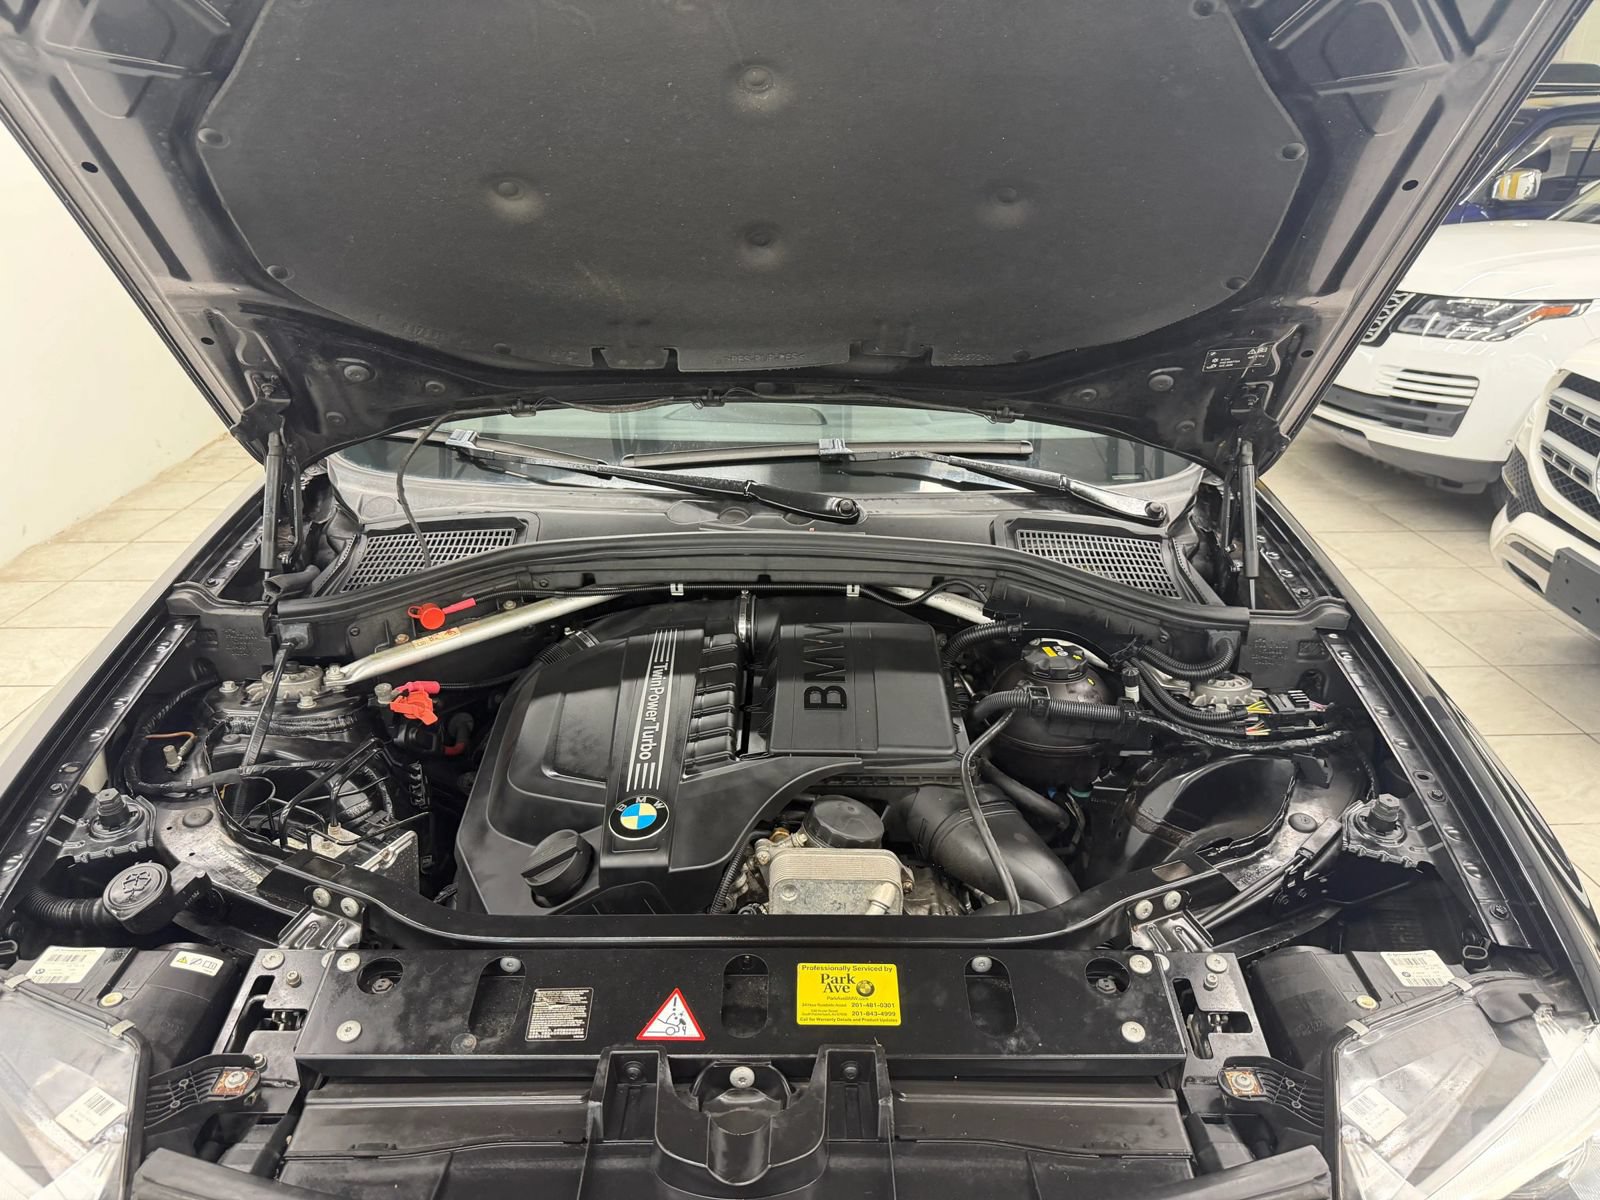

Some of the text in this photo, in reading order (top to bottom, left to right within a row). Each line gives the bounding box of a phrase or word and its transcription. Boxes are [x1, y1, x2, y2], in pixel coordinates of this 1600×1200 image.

[803, 624, 847, 711] BMW
[616, 796, 666, 811] BMW
[820, 973, 856, 984] Park
[823, 983, 850, 993] Ave
